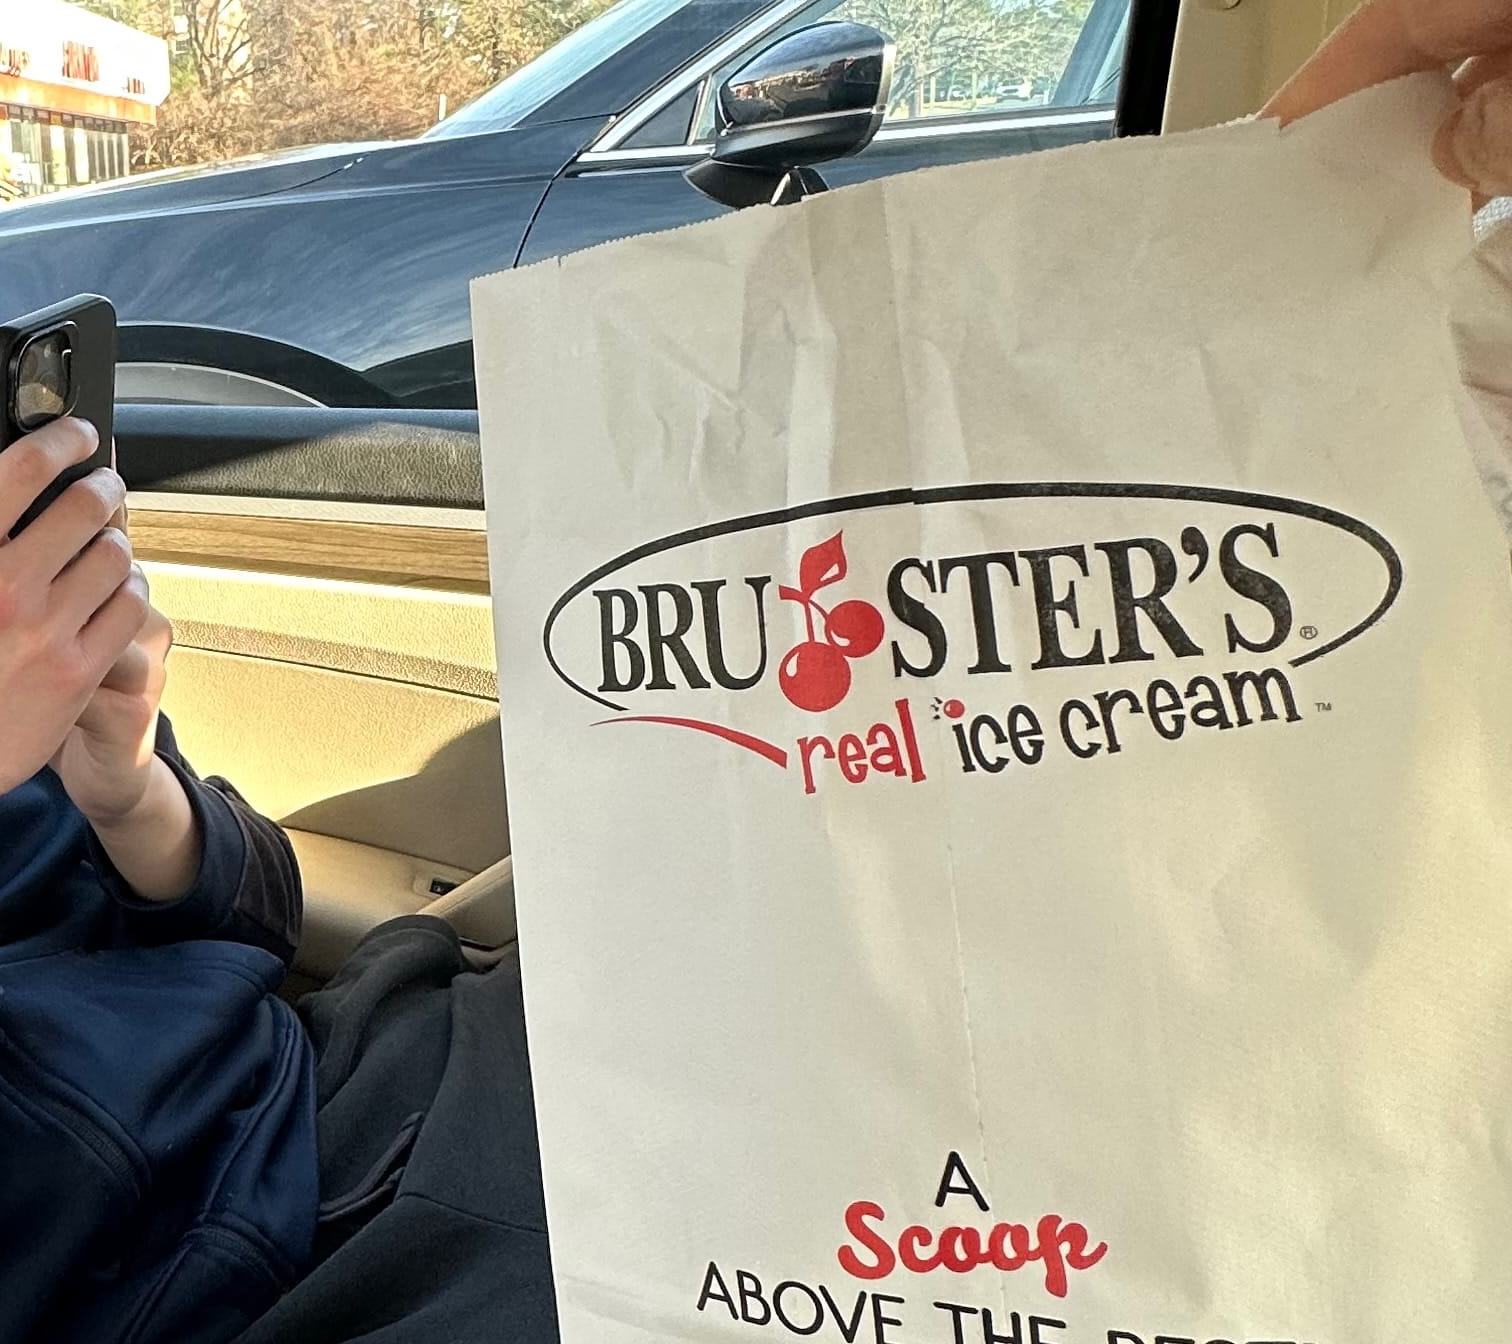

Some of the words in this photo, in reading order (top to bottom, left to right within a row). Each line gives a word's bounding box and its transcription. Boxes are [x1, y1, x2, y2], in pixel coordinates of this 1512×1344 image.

[797, 699, 926, 794] real
[945, 697, 1044, 774] ice
[1058, 666, 1303, 759] cream
[934, 1151, 990, 1212] A
[836, 1200, 1108, 1299] Scoop
